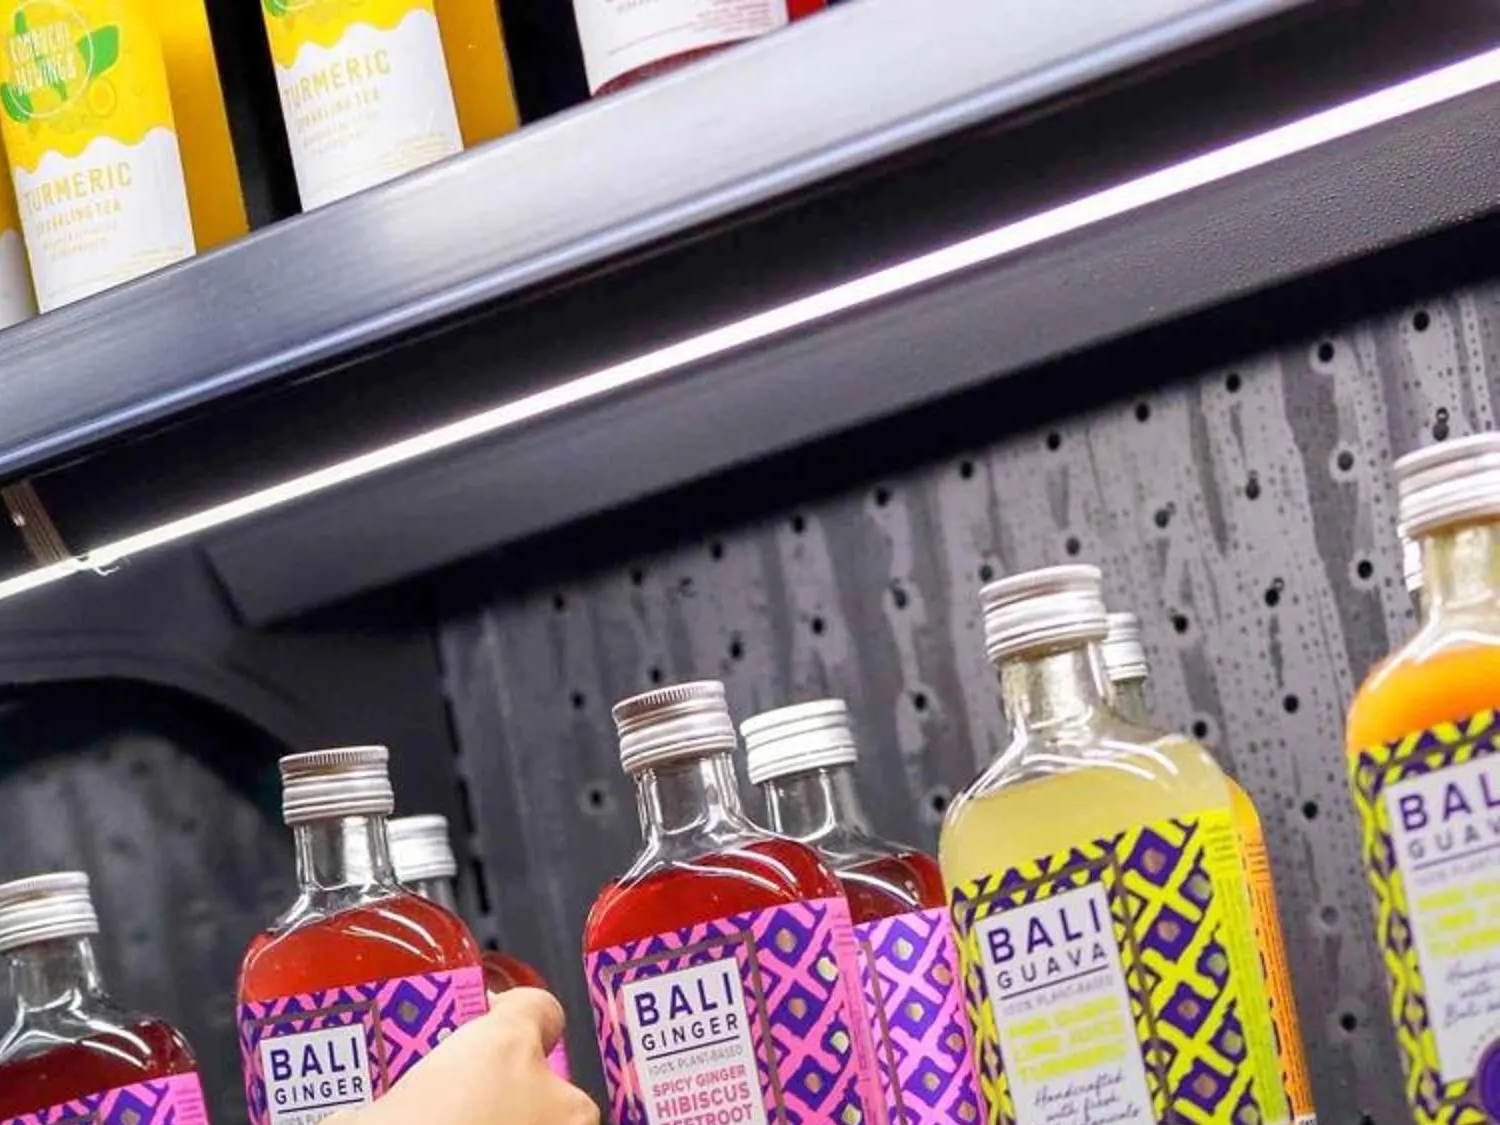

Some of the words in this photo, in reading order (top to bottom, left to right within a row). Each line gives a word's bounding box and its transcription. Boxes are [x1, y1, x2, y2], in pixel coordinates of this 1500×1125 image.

[284, 49, 390, 113] TURMERIC
[25, 161, 132, 215] TURMERIC
[1400, 771, 1500, 832] BAL
[1408, 817, 1500, 859] GUAV
[988, 898, 1101, 964] BALI
[997, 942, 1107, 989] GUAVA
[634, 973, 733, 1027] BALI
[641, 1013, 738, 1051] GINGER
[271, 1037, 360, 1081] BALI
[652, 1076, 691, 1097] SPICY
[695, 1064, 746, 1087] GINGER
[275, 1076, 363, 1105] GINGER
[656, 1081, 750, 1118] HIBISCUS
